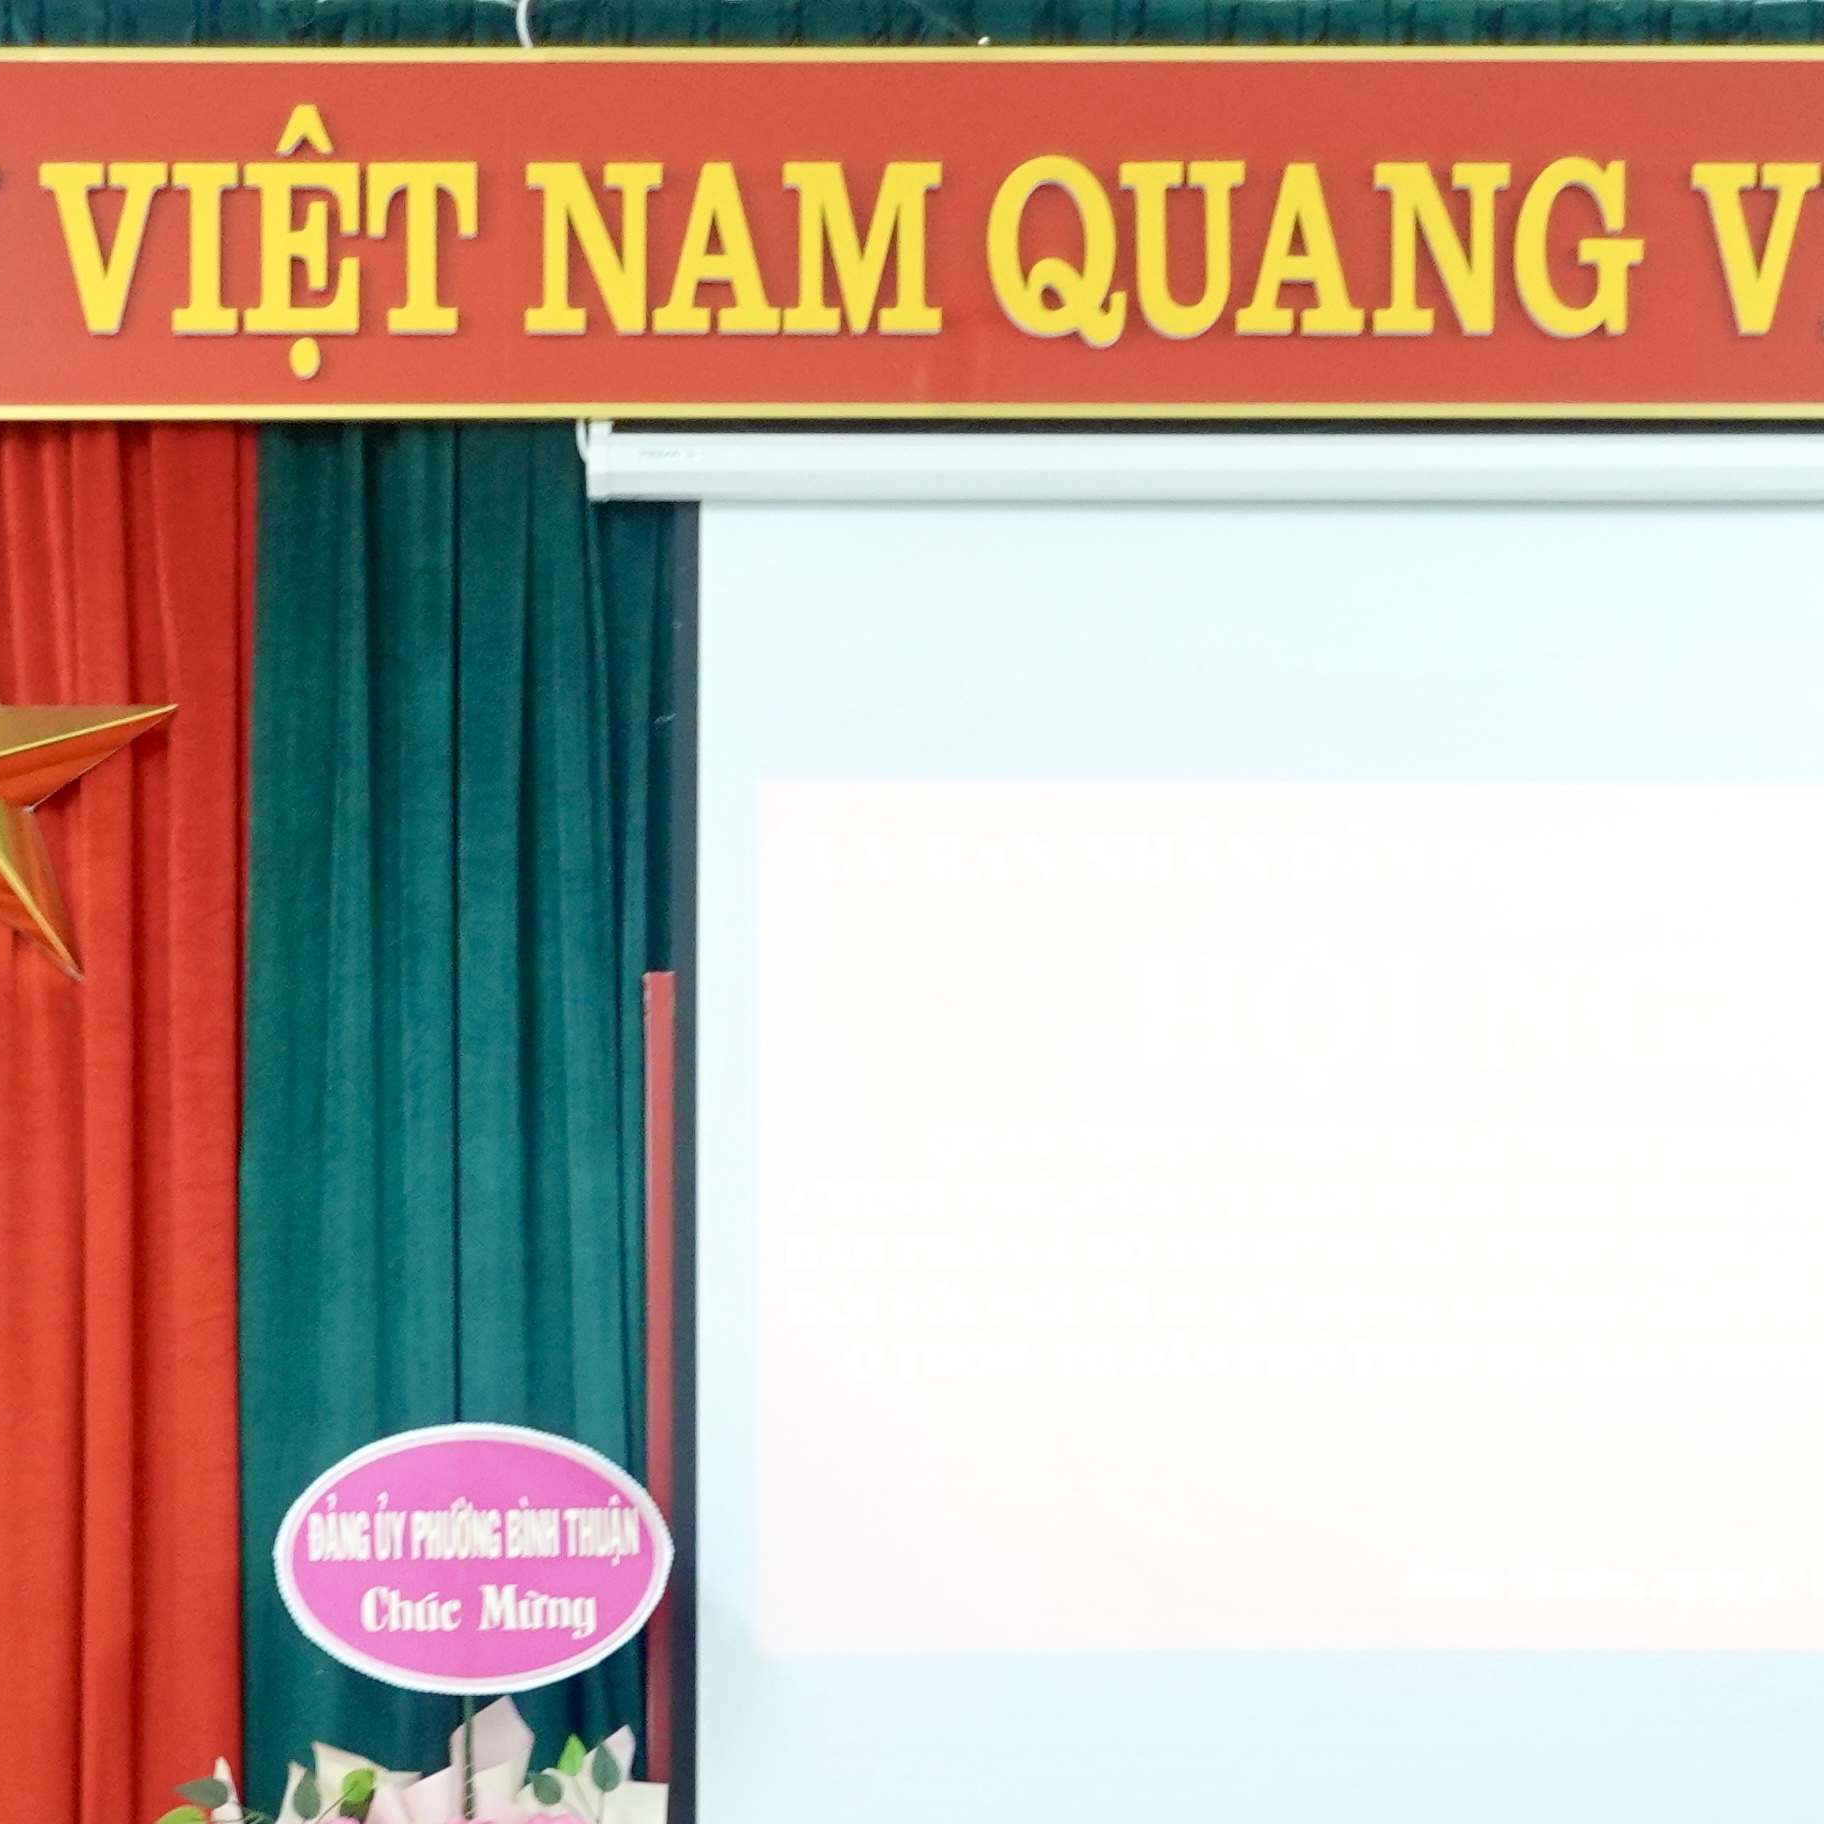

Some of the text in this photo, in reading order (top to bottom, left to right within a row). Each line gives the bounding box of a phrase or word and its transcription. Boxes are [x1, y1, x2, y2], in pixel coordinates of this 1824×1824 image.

[38, 104, 478, 378] VIỆT
[524, 161, 942, 335] NAM
[987, 154, 1644, 348] QUANG
[307, 1491, 641, 1567] ĐẢNG ỦY PHƯỜNG BÌNH THUẬN
[360, 1584, 597, 1640] Chúc Mừng
